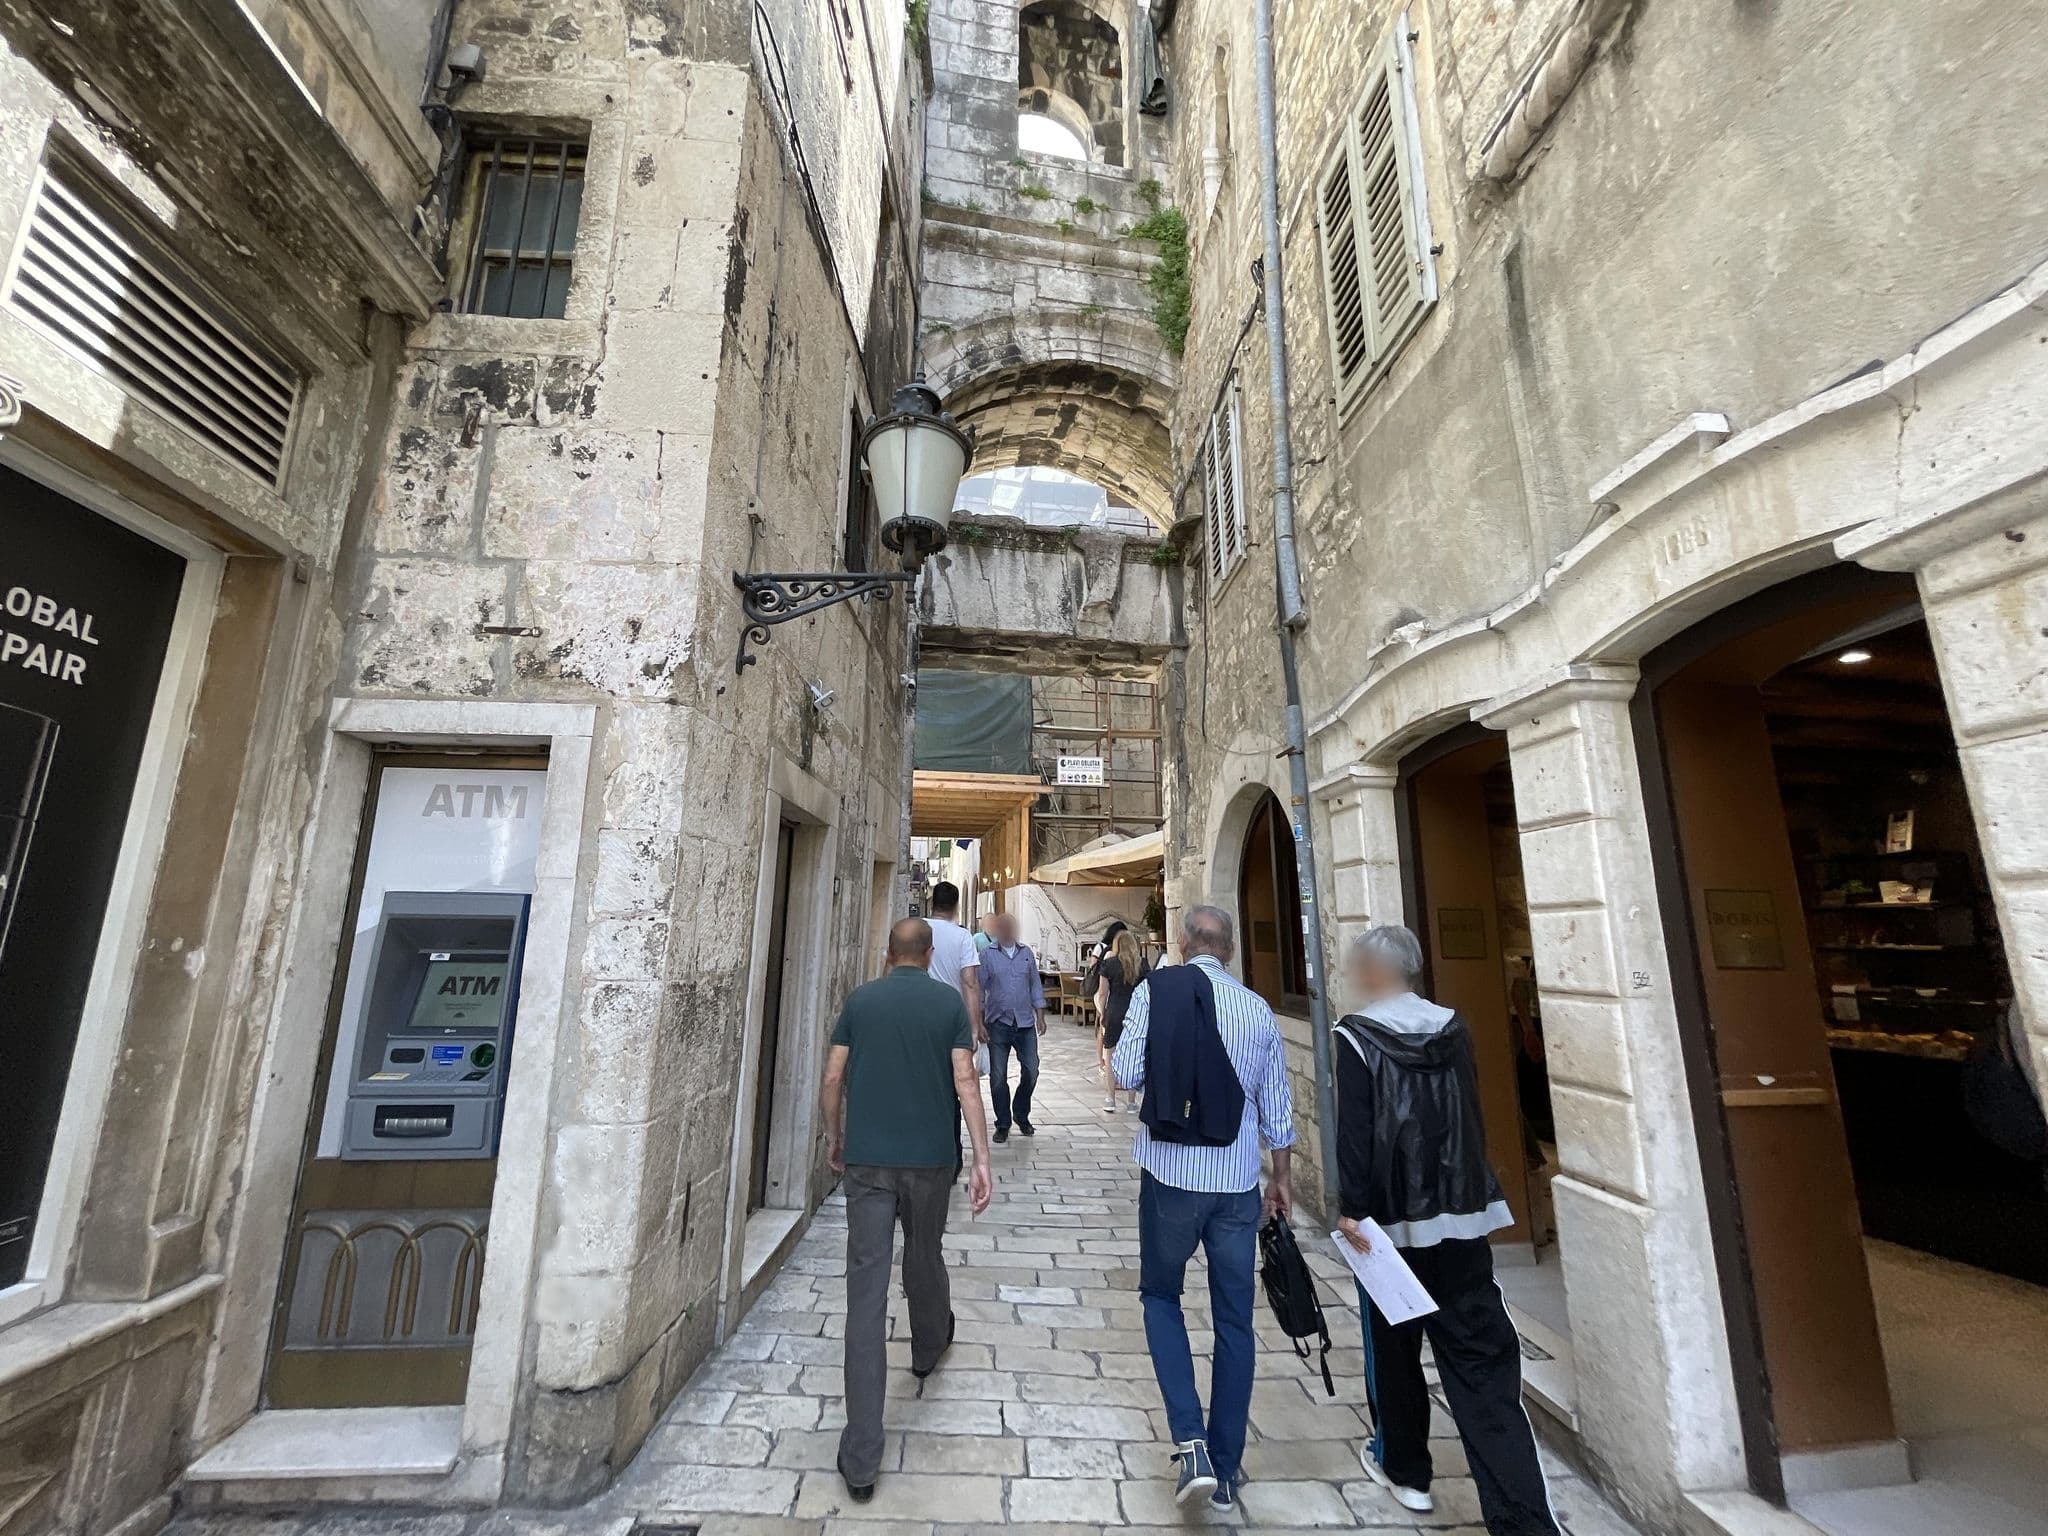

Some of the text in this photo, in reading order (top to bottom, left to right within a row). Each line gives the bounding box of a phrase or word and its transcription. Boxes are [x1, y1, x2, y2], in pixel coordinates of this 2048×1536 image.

[0, 586, 99, 646] OBAL
[0, 629, 87, 685] PAIR
[422, 784, 528, 818] ATM
[437, 976, 501, 995] ATM
